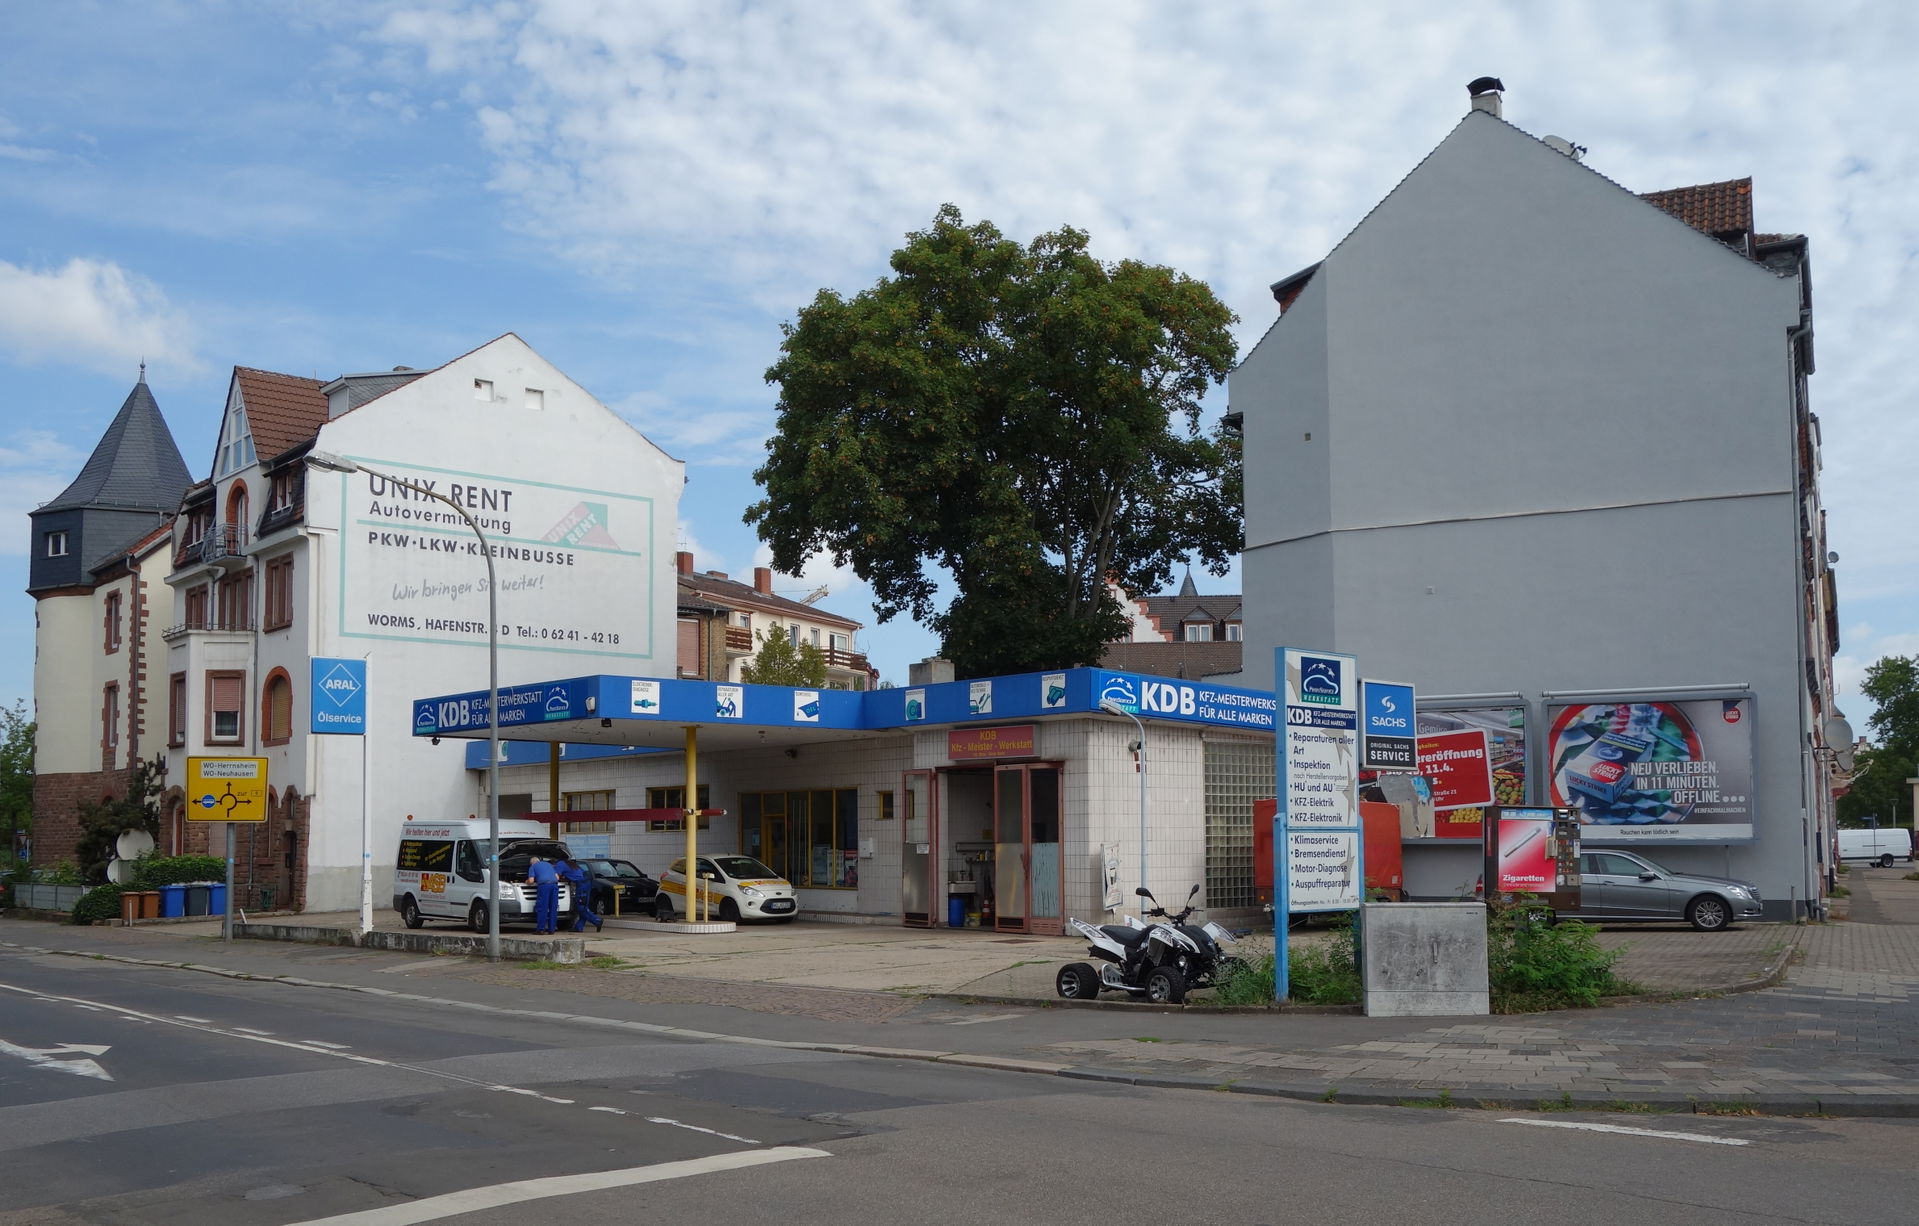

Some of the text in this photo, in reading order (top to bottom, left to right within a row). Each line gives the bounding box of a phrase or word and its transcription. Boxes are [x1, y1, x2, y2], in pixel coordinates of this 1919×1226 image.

[370, 501, 511, 534] Autovermietung
[547, 511, 577, 543] UNIX
[567, 513, 597, 545] RENT
[393, 584, 418, 600] Wir
[422, 579, 472, 601] bringen
[477, 577, 497, 592] Si
[425, 619, 487, 634] HAFENSTR.
[517, 626, 538, 638] Tel.:
[325, 679, 356, 690] ARAL
[1142, 681, 1196, 715] KDB
[317, 711, 362, 724] Ölservice
[438, 700, 470, 728] KDB
[472, 711, 483, 725] FÜR
[499, 708, 526, 722] MARKEN
[1199, 704, 1272, 725] FÜR ALLE MARKEN
[1287, 707, 1313, 724] KDB
[1371, 716, 1407, 728] SACHS
[980, 730, 997, 740] KDB
[1293, 731, 1355, 745] Reparaturen aller
[1293, 746, 1304, 755] Art
[1370, 751, 1410, 761] SERVICE
[1293, 759, 1331, 771] Inspektion
[1426, 763, 1454, 774] 11.4.
[1599, 764, 1621, 774] LUCKY
[1630, 761, 1719, 775] NEU VERLIEBEN.
[1593, 768, 1618, 780] STRIKE
[1294, 782, 1333, 792] HU und AU
[1637, 776, 1720, 790] IN 11 MINUTEN.
[1294, 797, 1334, 807] KFZ-Elektrik
[1294, 812, 1343, 822] KFZ-Elektronik
[1294, 835, 1339, 845] Klimaservice
[1294, 849, 1346, 858] Bremsendienst
[1295, 863, 1348, 875] Motor-Diagnose
[1502, 874, 1545, 882] Zigaretten
[1295, 879, 1350, 891] Auspuffreparatur
